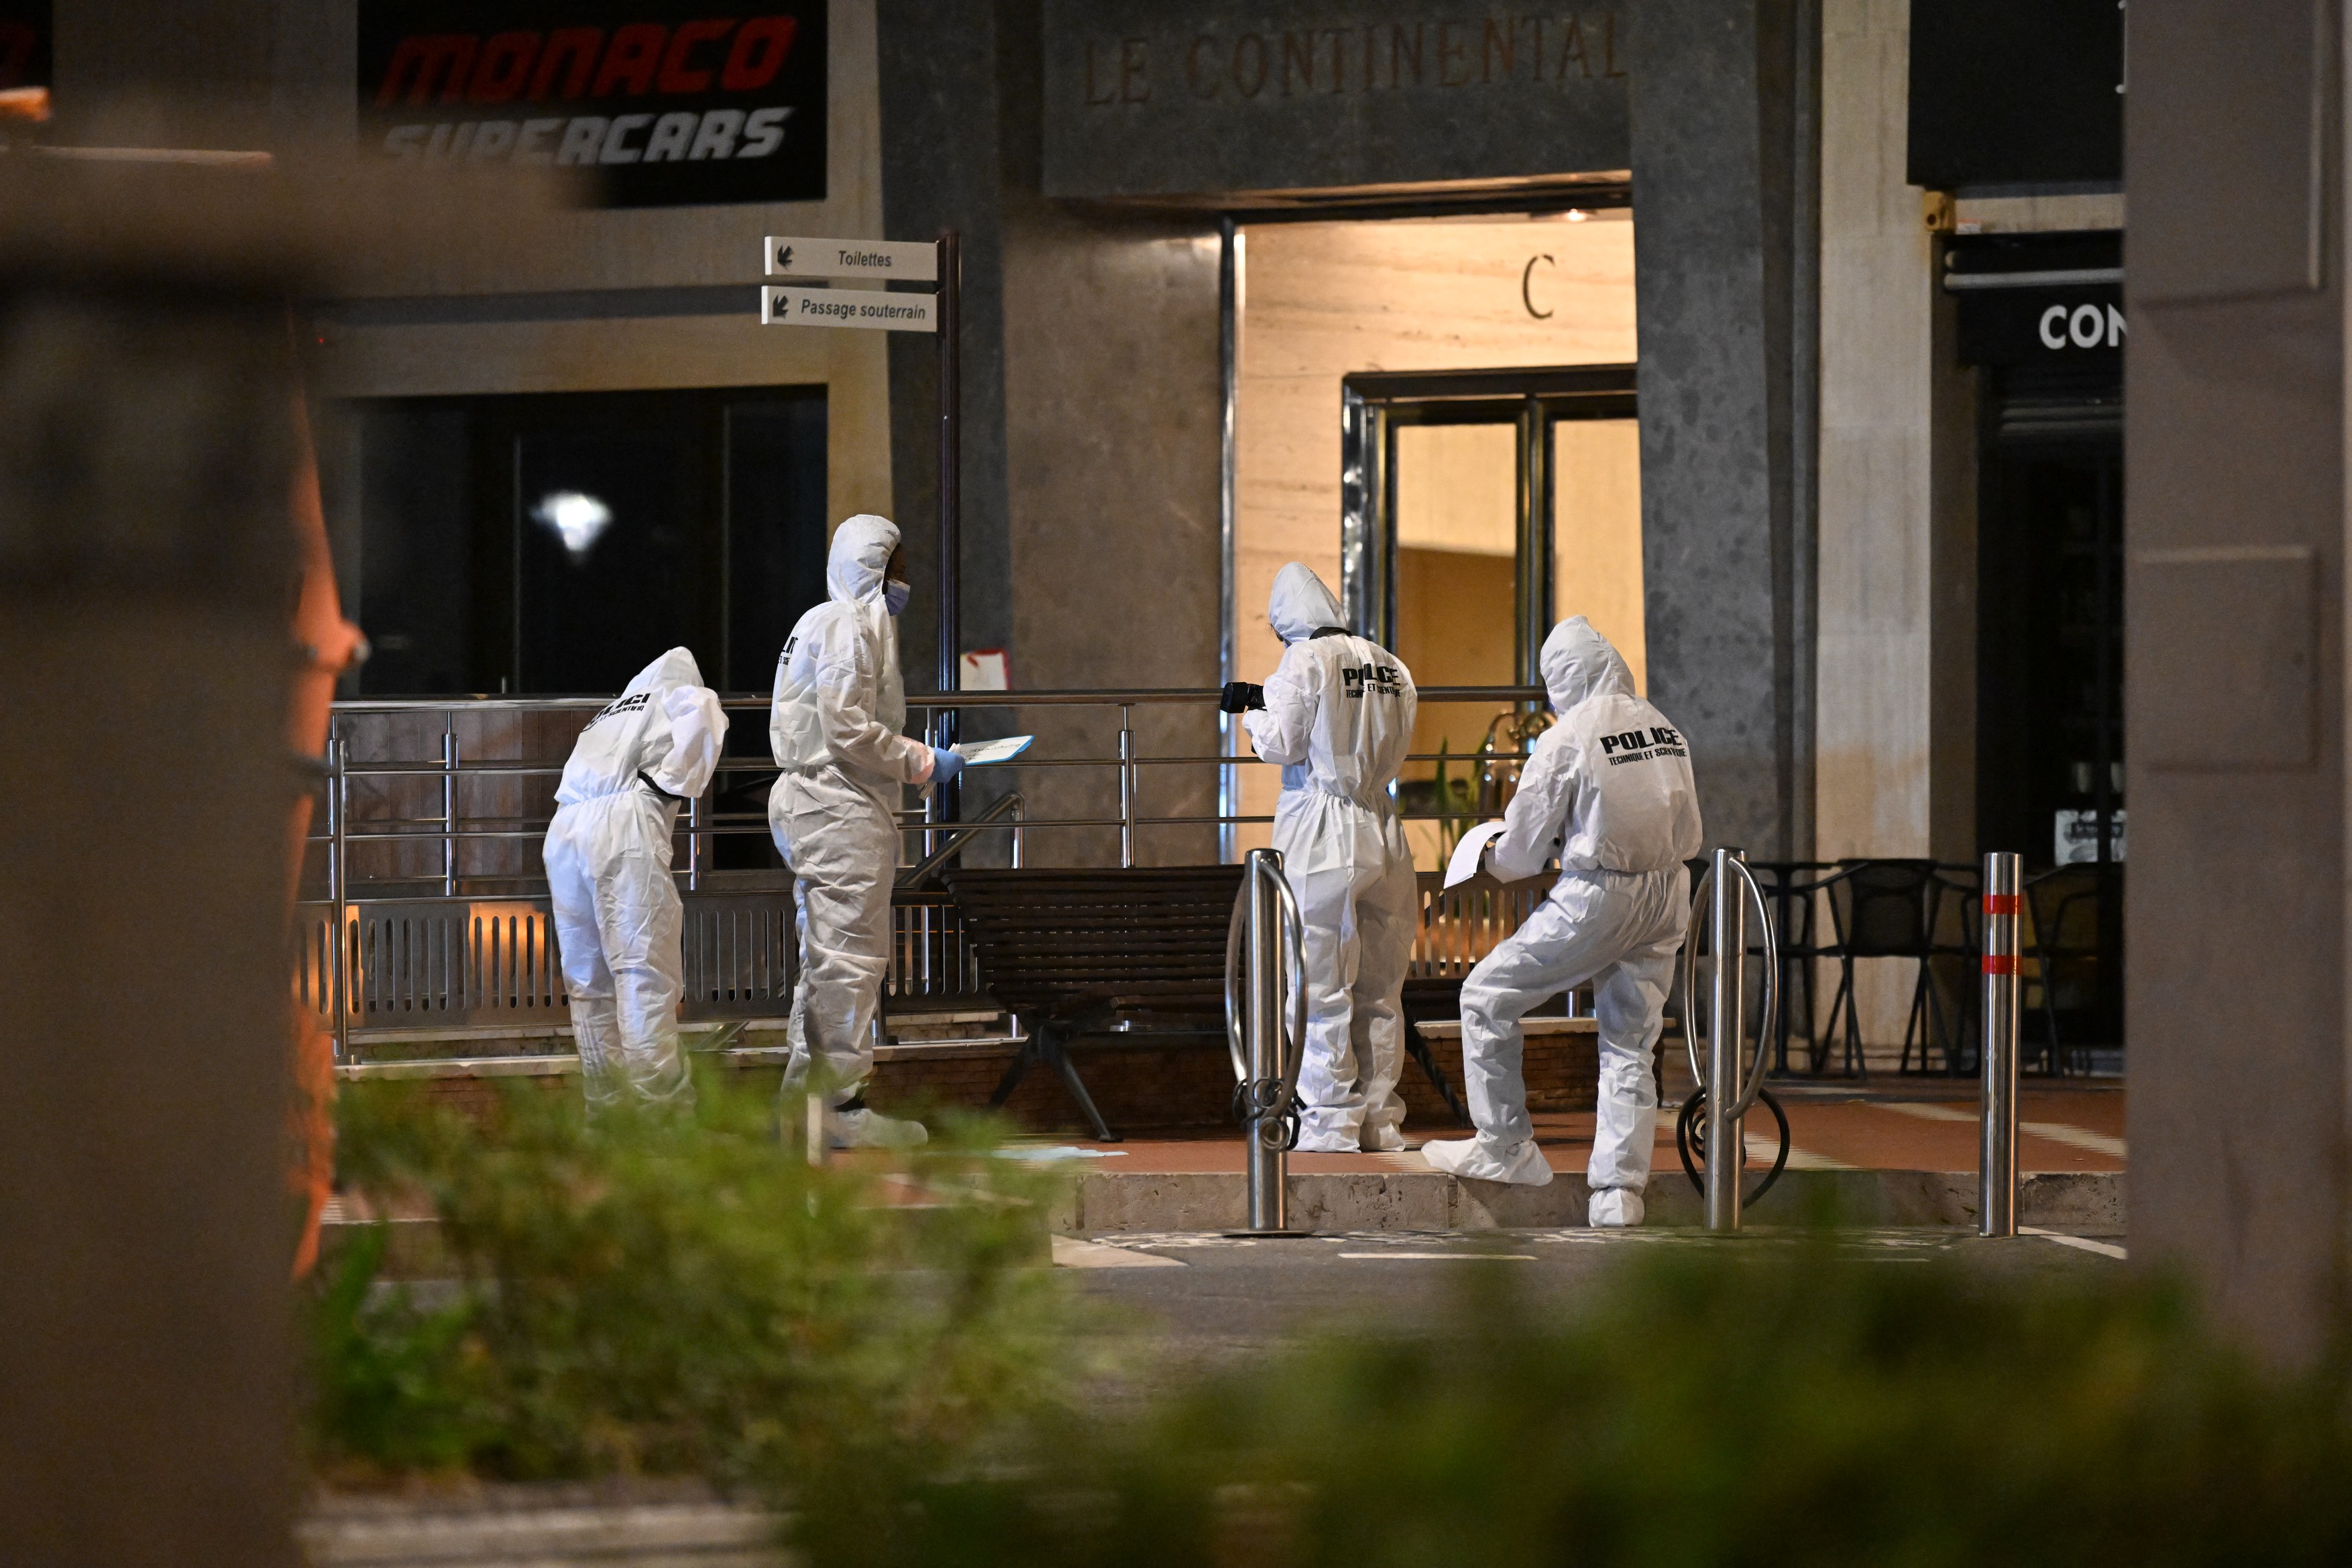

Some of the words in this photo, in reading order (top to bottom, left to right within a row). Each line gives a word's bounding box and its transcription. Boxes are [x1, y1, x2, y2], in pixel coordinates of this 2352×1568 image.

[374, 15, 798, 107] MONACO
[1084, 37, 1151, 106] LE
[1186, 11, 1628, 100] CONTINENTAL
[384, 107, 797, 166] SUPERCARS
[838, 250, 892, 267] Toilettes
[1522, 254, 1555, 320] C
[801, 298, 856, 319] Passage
[860, 304, 926, 320] souterrain
[1342, 663, 1401, 686] PLCE
[1367, 683, 1376, 692] ET
[608, 706, 645, 718] SCIENTIFIQ
[1600, 727, 1682, 754] POLICE
[1608, 752, 1644, 766] TECHNIQUE
[1644, 750, 1653, 760] ET
